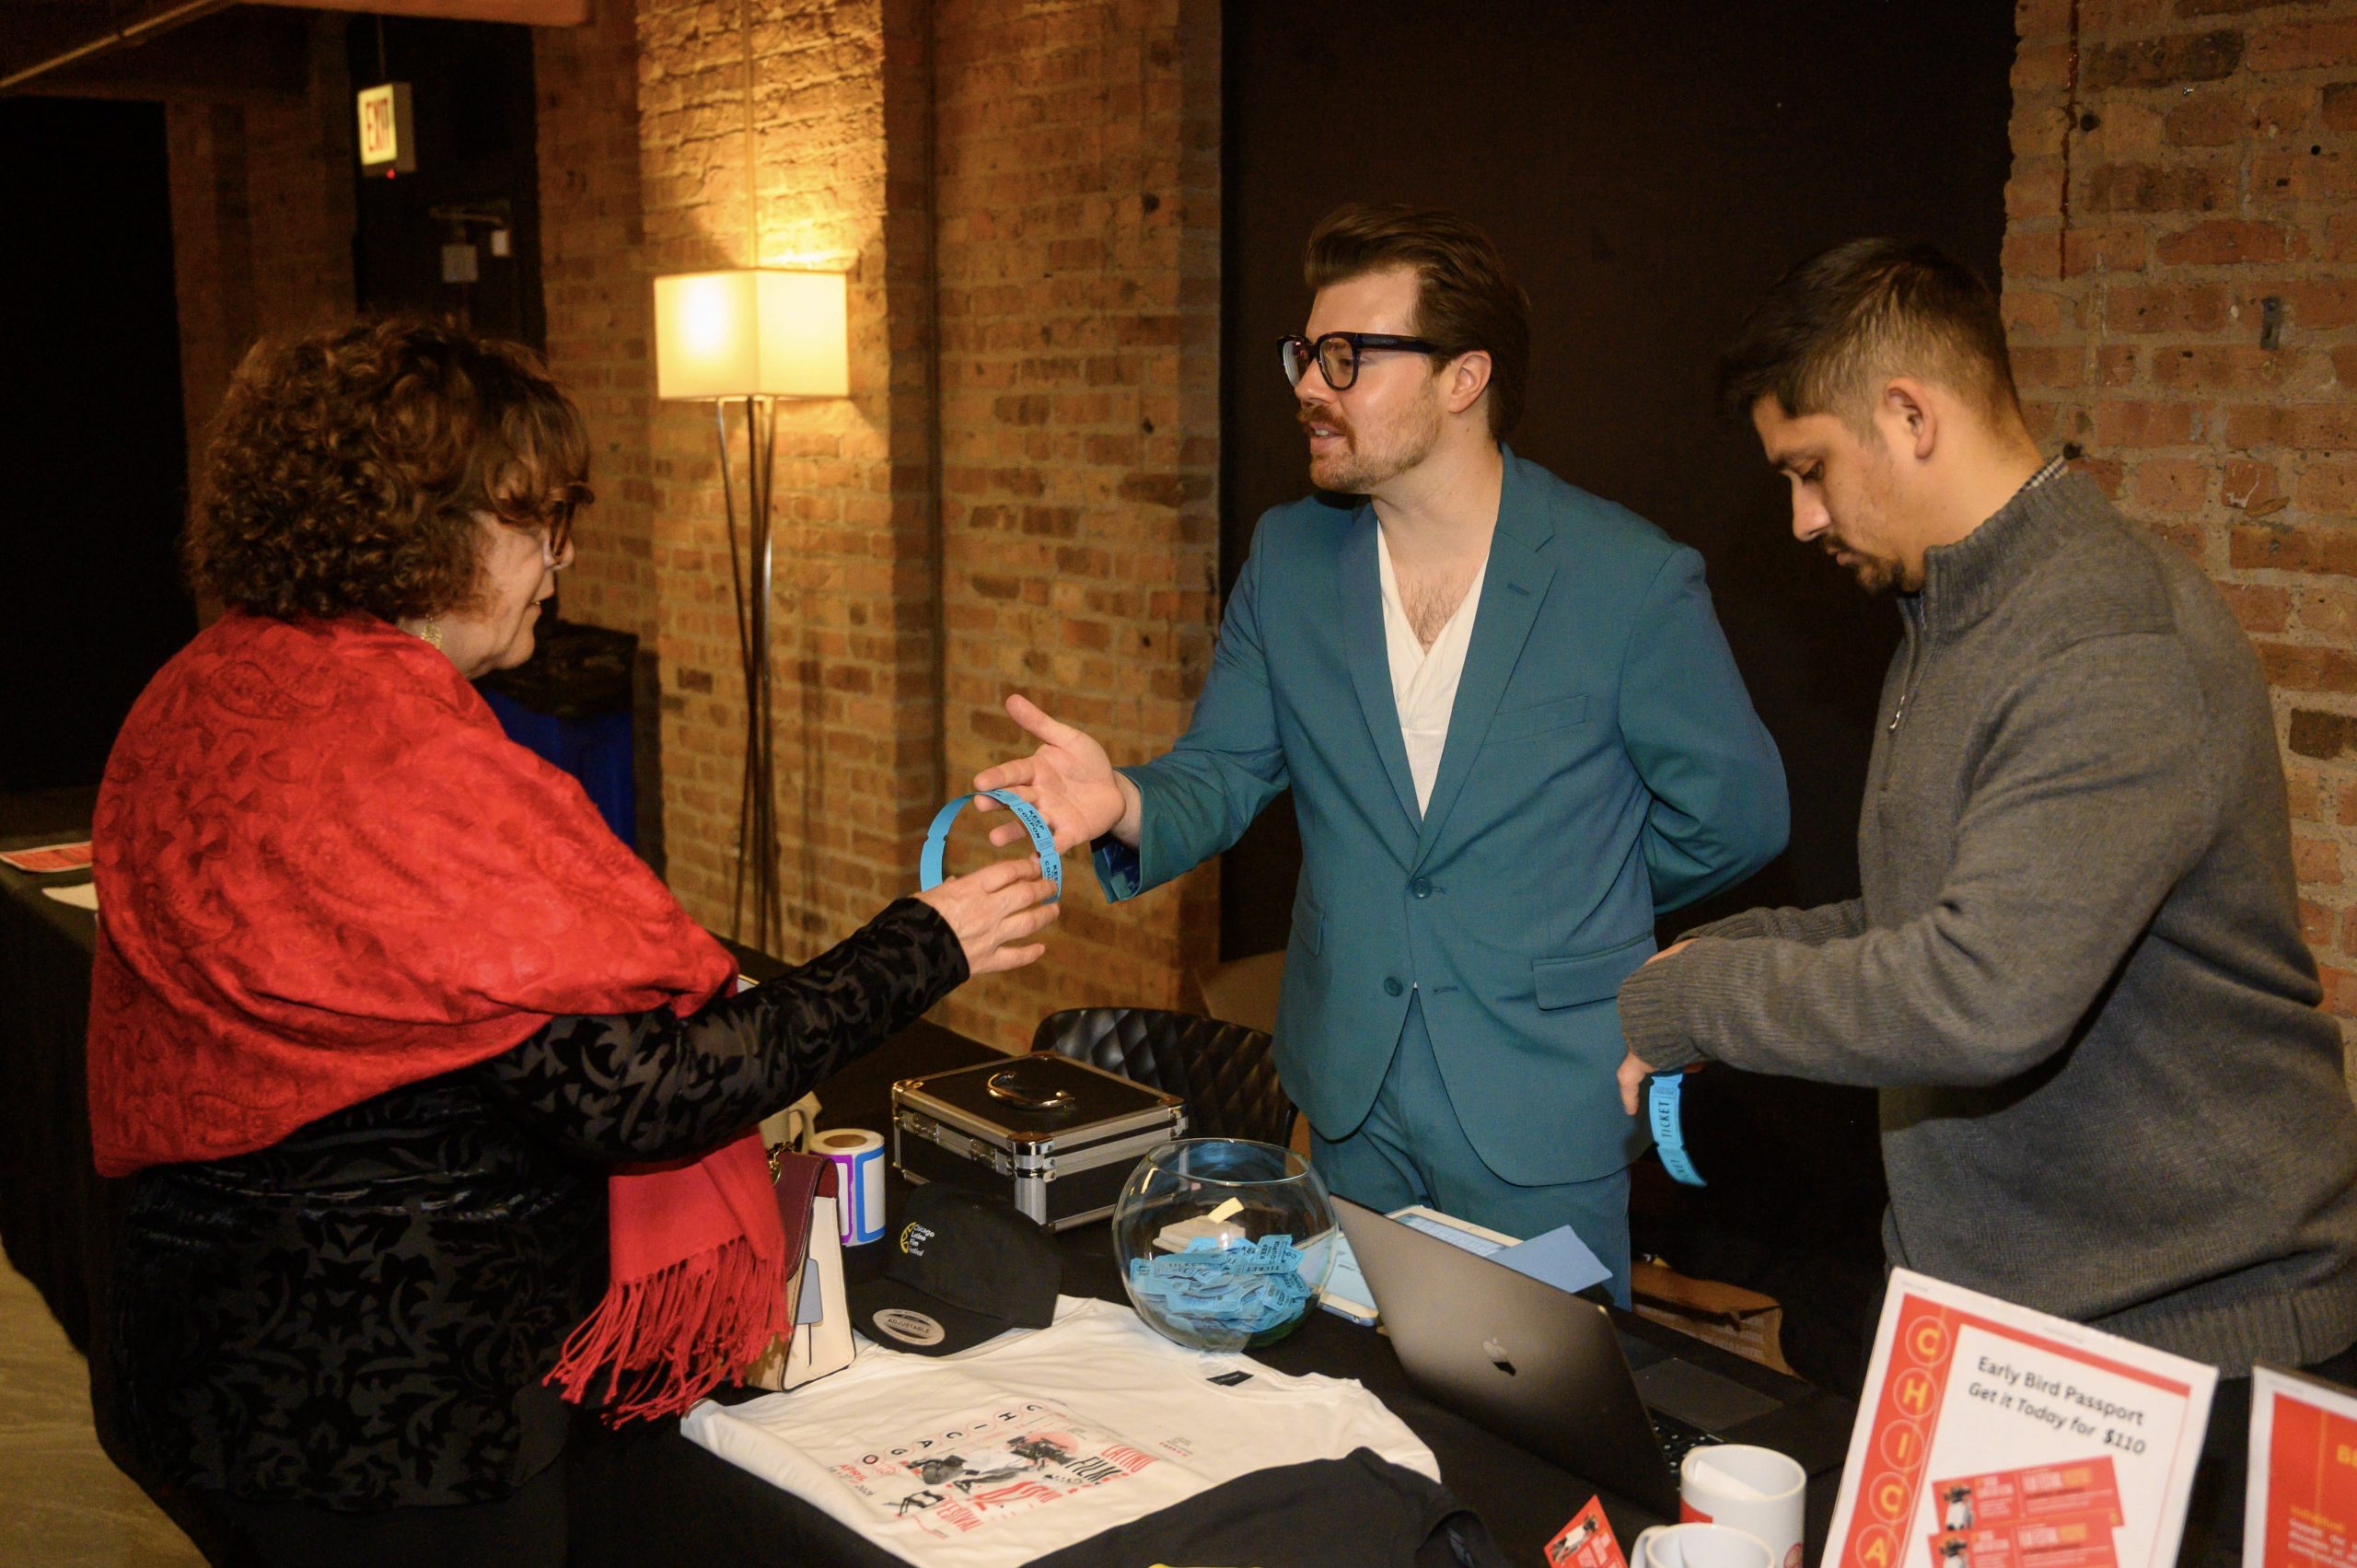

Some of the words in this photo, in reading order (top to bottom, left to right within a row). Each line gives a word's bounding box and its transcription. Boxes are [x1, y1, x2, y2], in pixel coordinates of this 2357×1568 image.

[366, 99, 389, 154] EXIT
[1017, 807, 1041, 839] COUPON
[1028, 809, 1045, 830] KEEP
[1658, 1100, 1672, 1138] TICKET
[911, 1231, 926, 1241] Latino
[913, 1224, 935, 1237] Chicago
[888, 1318, 931, 1334] ADJUSTABLE
[1978, 1355, 2021, 1387] Early
[2025, 1371, 2061, 1398] Bird
[2064, 1385, 2144, 1426] Passport
[1968, 1381, 1998, 1403] Get
[2016, 1397, 2068, 1431] Today
[2069, 1415, 2096, 1437] for
[2103, 1428, 2147, 1455] $110
[1101, 1443, 1160, 1474] LATINO
